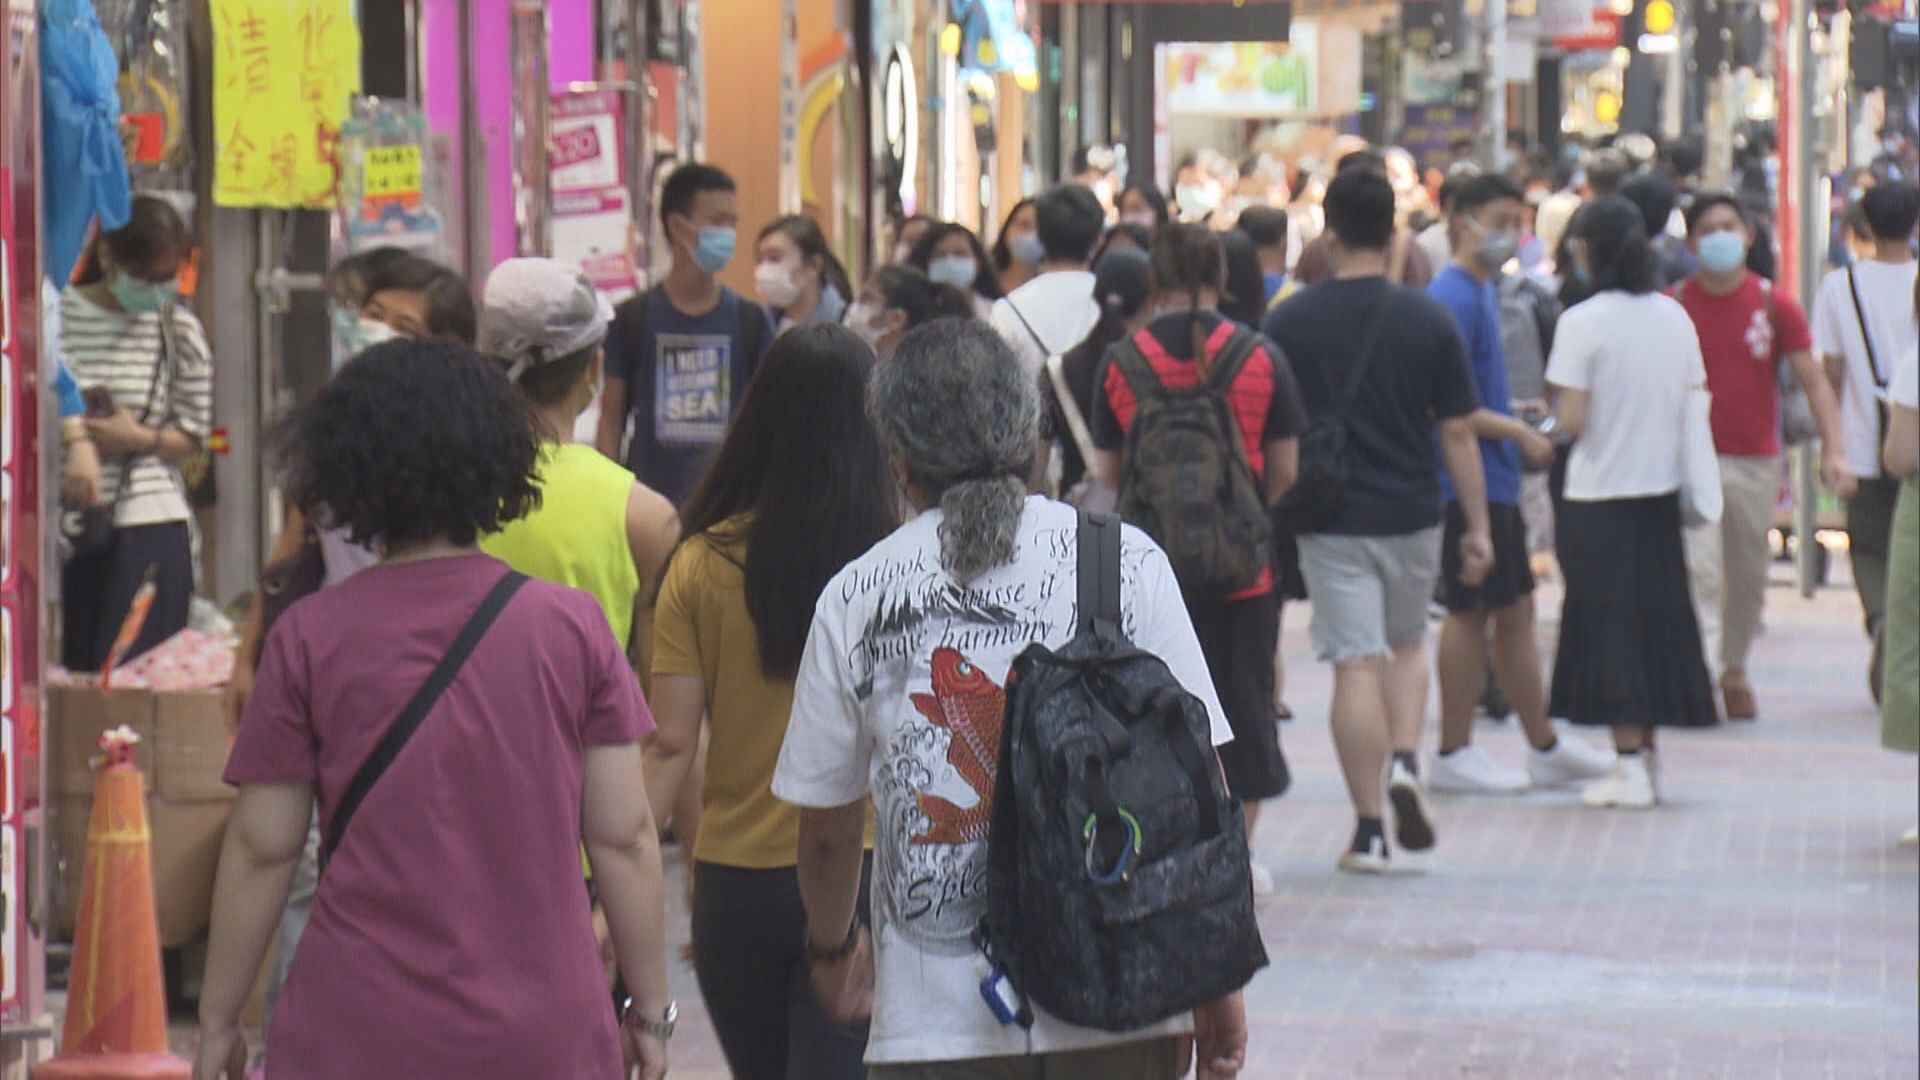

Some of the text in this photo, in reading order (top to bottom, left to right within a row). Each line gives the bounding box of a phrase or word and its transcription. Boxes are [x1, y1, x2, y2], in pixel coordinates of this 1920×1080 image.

[666, 389, 722, 420] SEA
[842, 546, 926, 604] Outlook
[939, 617, 1055, 651] harmony
